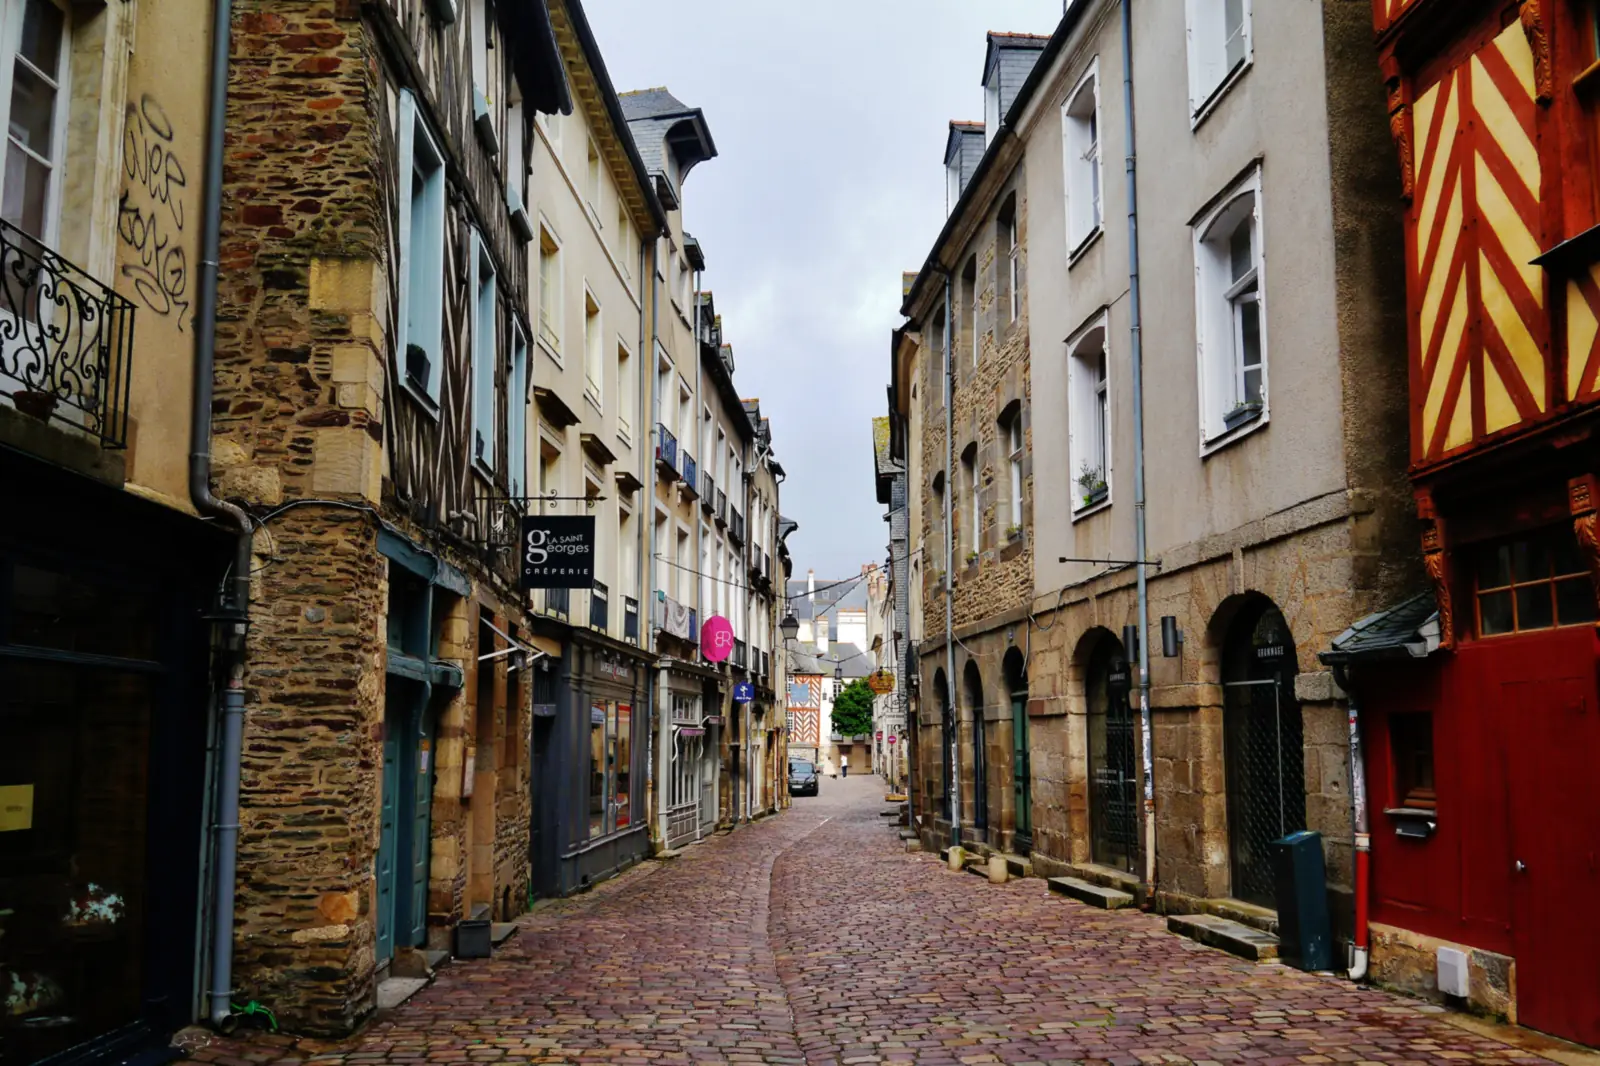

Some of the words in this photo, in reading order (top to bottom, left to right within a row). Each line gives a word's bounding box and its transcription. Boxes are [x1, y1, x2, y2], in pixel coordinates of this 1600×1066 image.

[546, 537, 558, 545] LA
[559, 534, 584, 544] SAINT
[525, 567, 589, 575] CRÊPERIE
